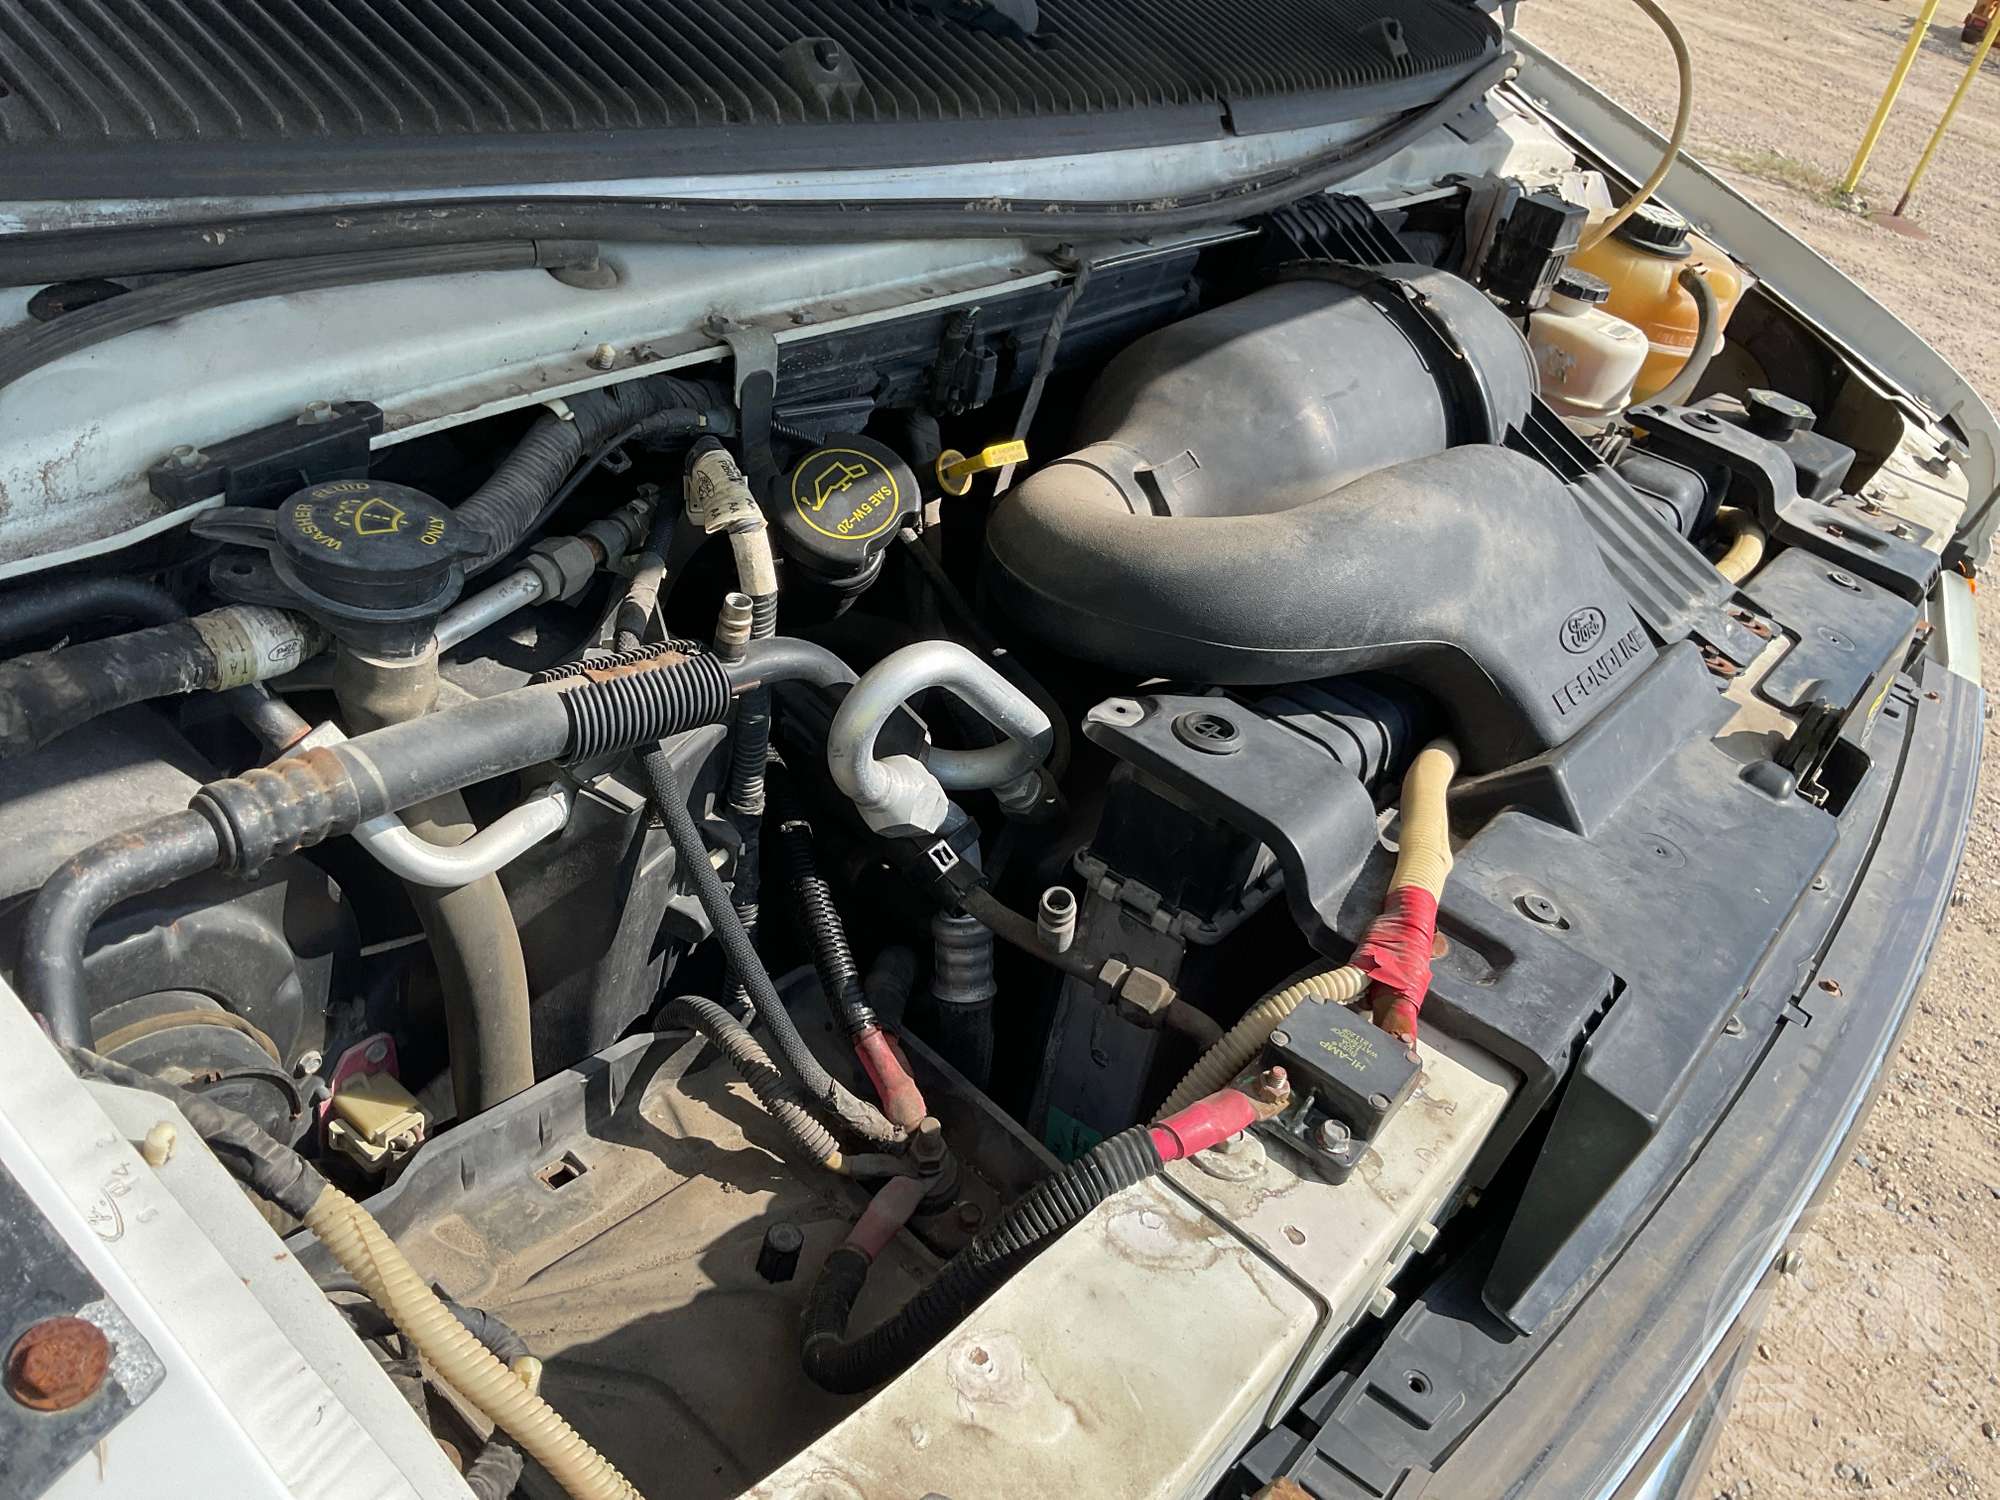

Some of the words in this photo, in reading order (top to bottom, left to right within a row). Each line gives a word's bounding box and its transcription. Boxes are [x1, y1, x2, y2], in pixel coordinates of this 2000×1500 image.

[311, 481, 370, 499] FLUID
[868, 485, 892, 507] SAE
[293, 503, 343, 552] WASHER
[419, 515, 446, 545] ONLY
[836, 502, 871, 534] 5W-20
[1566, 610, 1602, 650] Ford
[1551, 625, 1648, 715] ECONOLINE
[1319, 1040, 1366, 1071] HI-AMP
